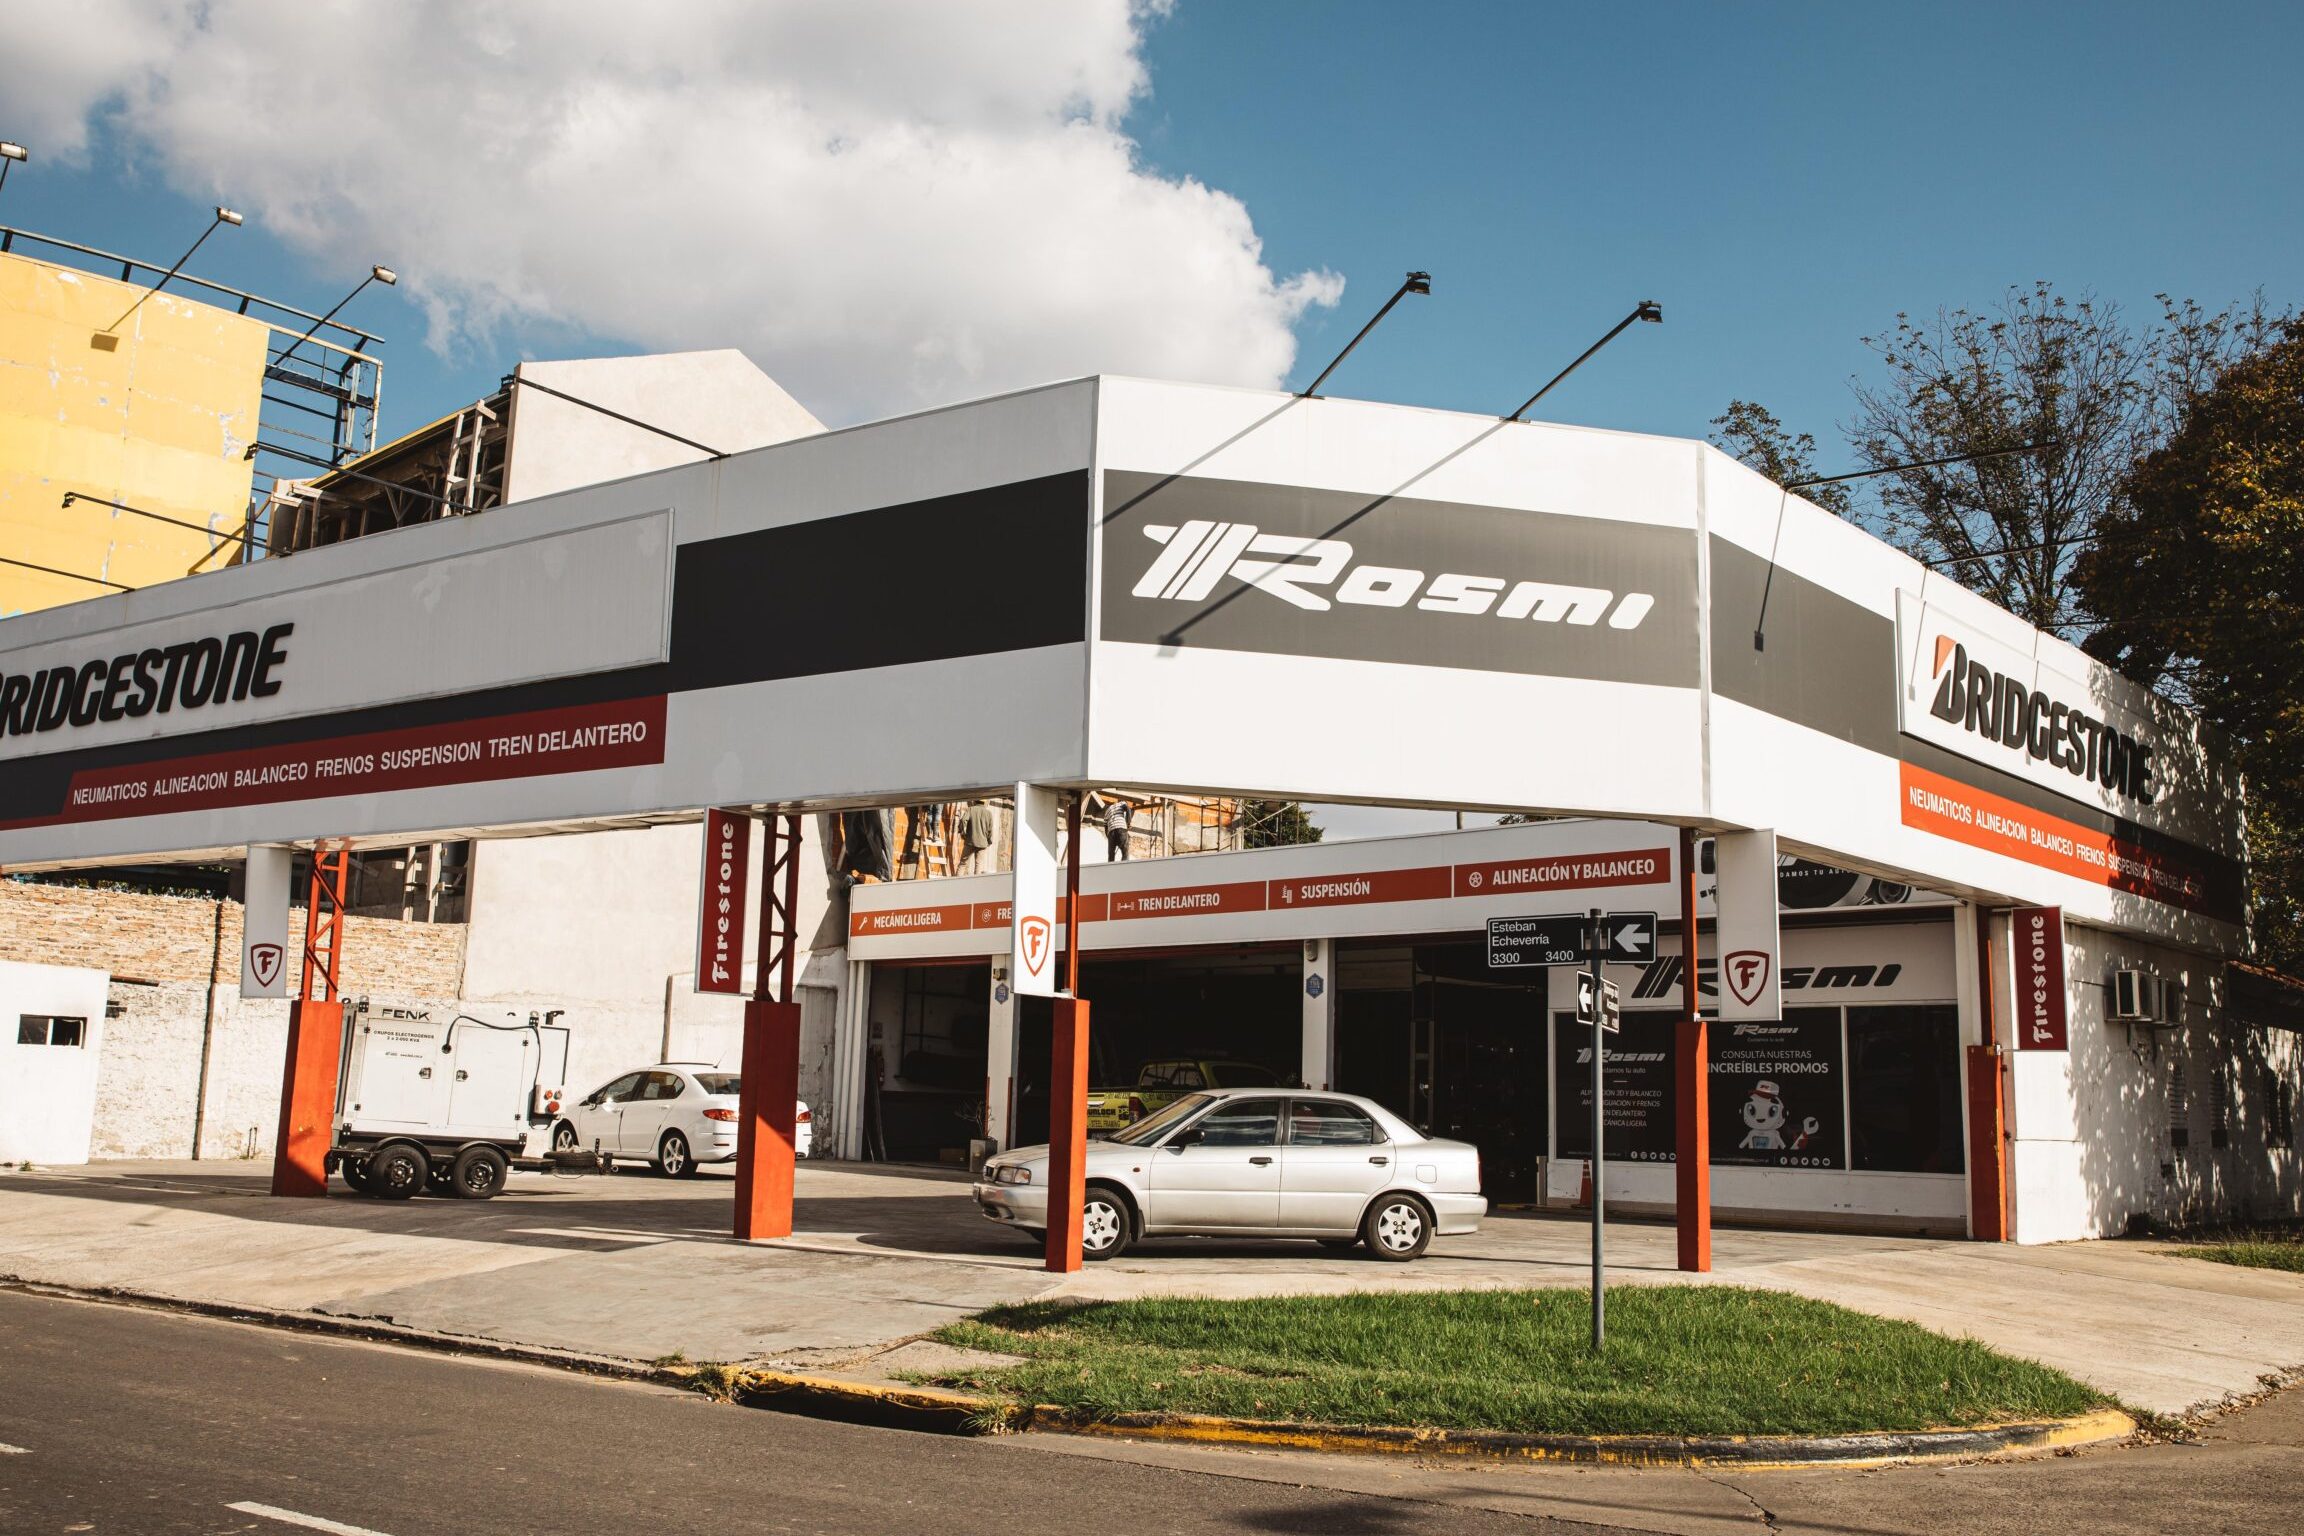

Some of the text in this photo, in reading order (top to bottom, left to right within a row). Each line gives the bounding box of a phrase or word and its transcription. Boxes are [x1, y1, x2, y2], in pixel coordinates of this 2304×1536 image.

[0, 622, 295, 740] RIDGESTONE
[1930, 635, 2154, 806] BRIDGESTONE
[73, 721, 647, 805] NEUMATICOS ALINEACION BALANCEO FRENOS SUSPENSION TREN DELANTERO
[1909, 786, 1972, 824] NEUMATICOS
[1975, 809, 2028, 842] ALINEACION
[2031, 828, 2073, 856] BALANCEO
[2076, 843, 2106, 867] FRENOS
[2108, 853, 2150, 881] SUSPENSION
[1492, 859, 1655, 885] ALINEACIÓN Y BALANCEO
[1301, 878, 1371, 899] SUSPENSIÓN
[711, 822, 734, 984] Firestone
[1138, 893, 1220, 911] TREN DELANTERO
[874, 911, 942, 929] MECÁNICA LIGERA
[1491, 920, 1536, 933] Esteban
[1491, 934, 1550, 947] Echeverría
[1492, 950, 1574, 964] 3300 3400
[2031, 915, 2054, 1044] Firestone
[382, 1008, 430, 1021] FENK
[1767, 1050, 1812, 1059] NUESTRAS
[1775, 1062, 1829, 1074] PROMOS
